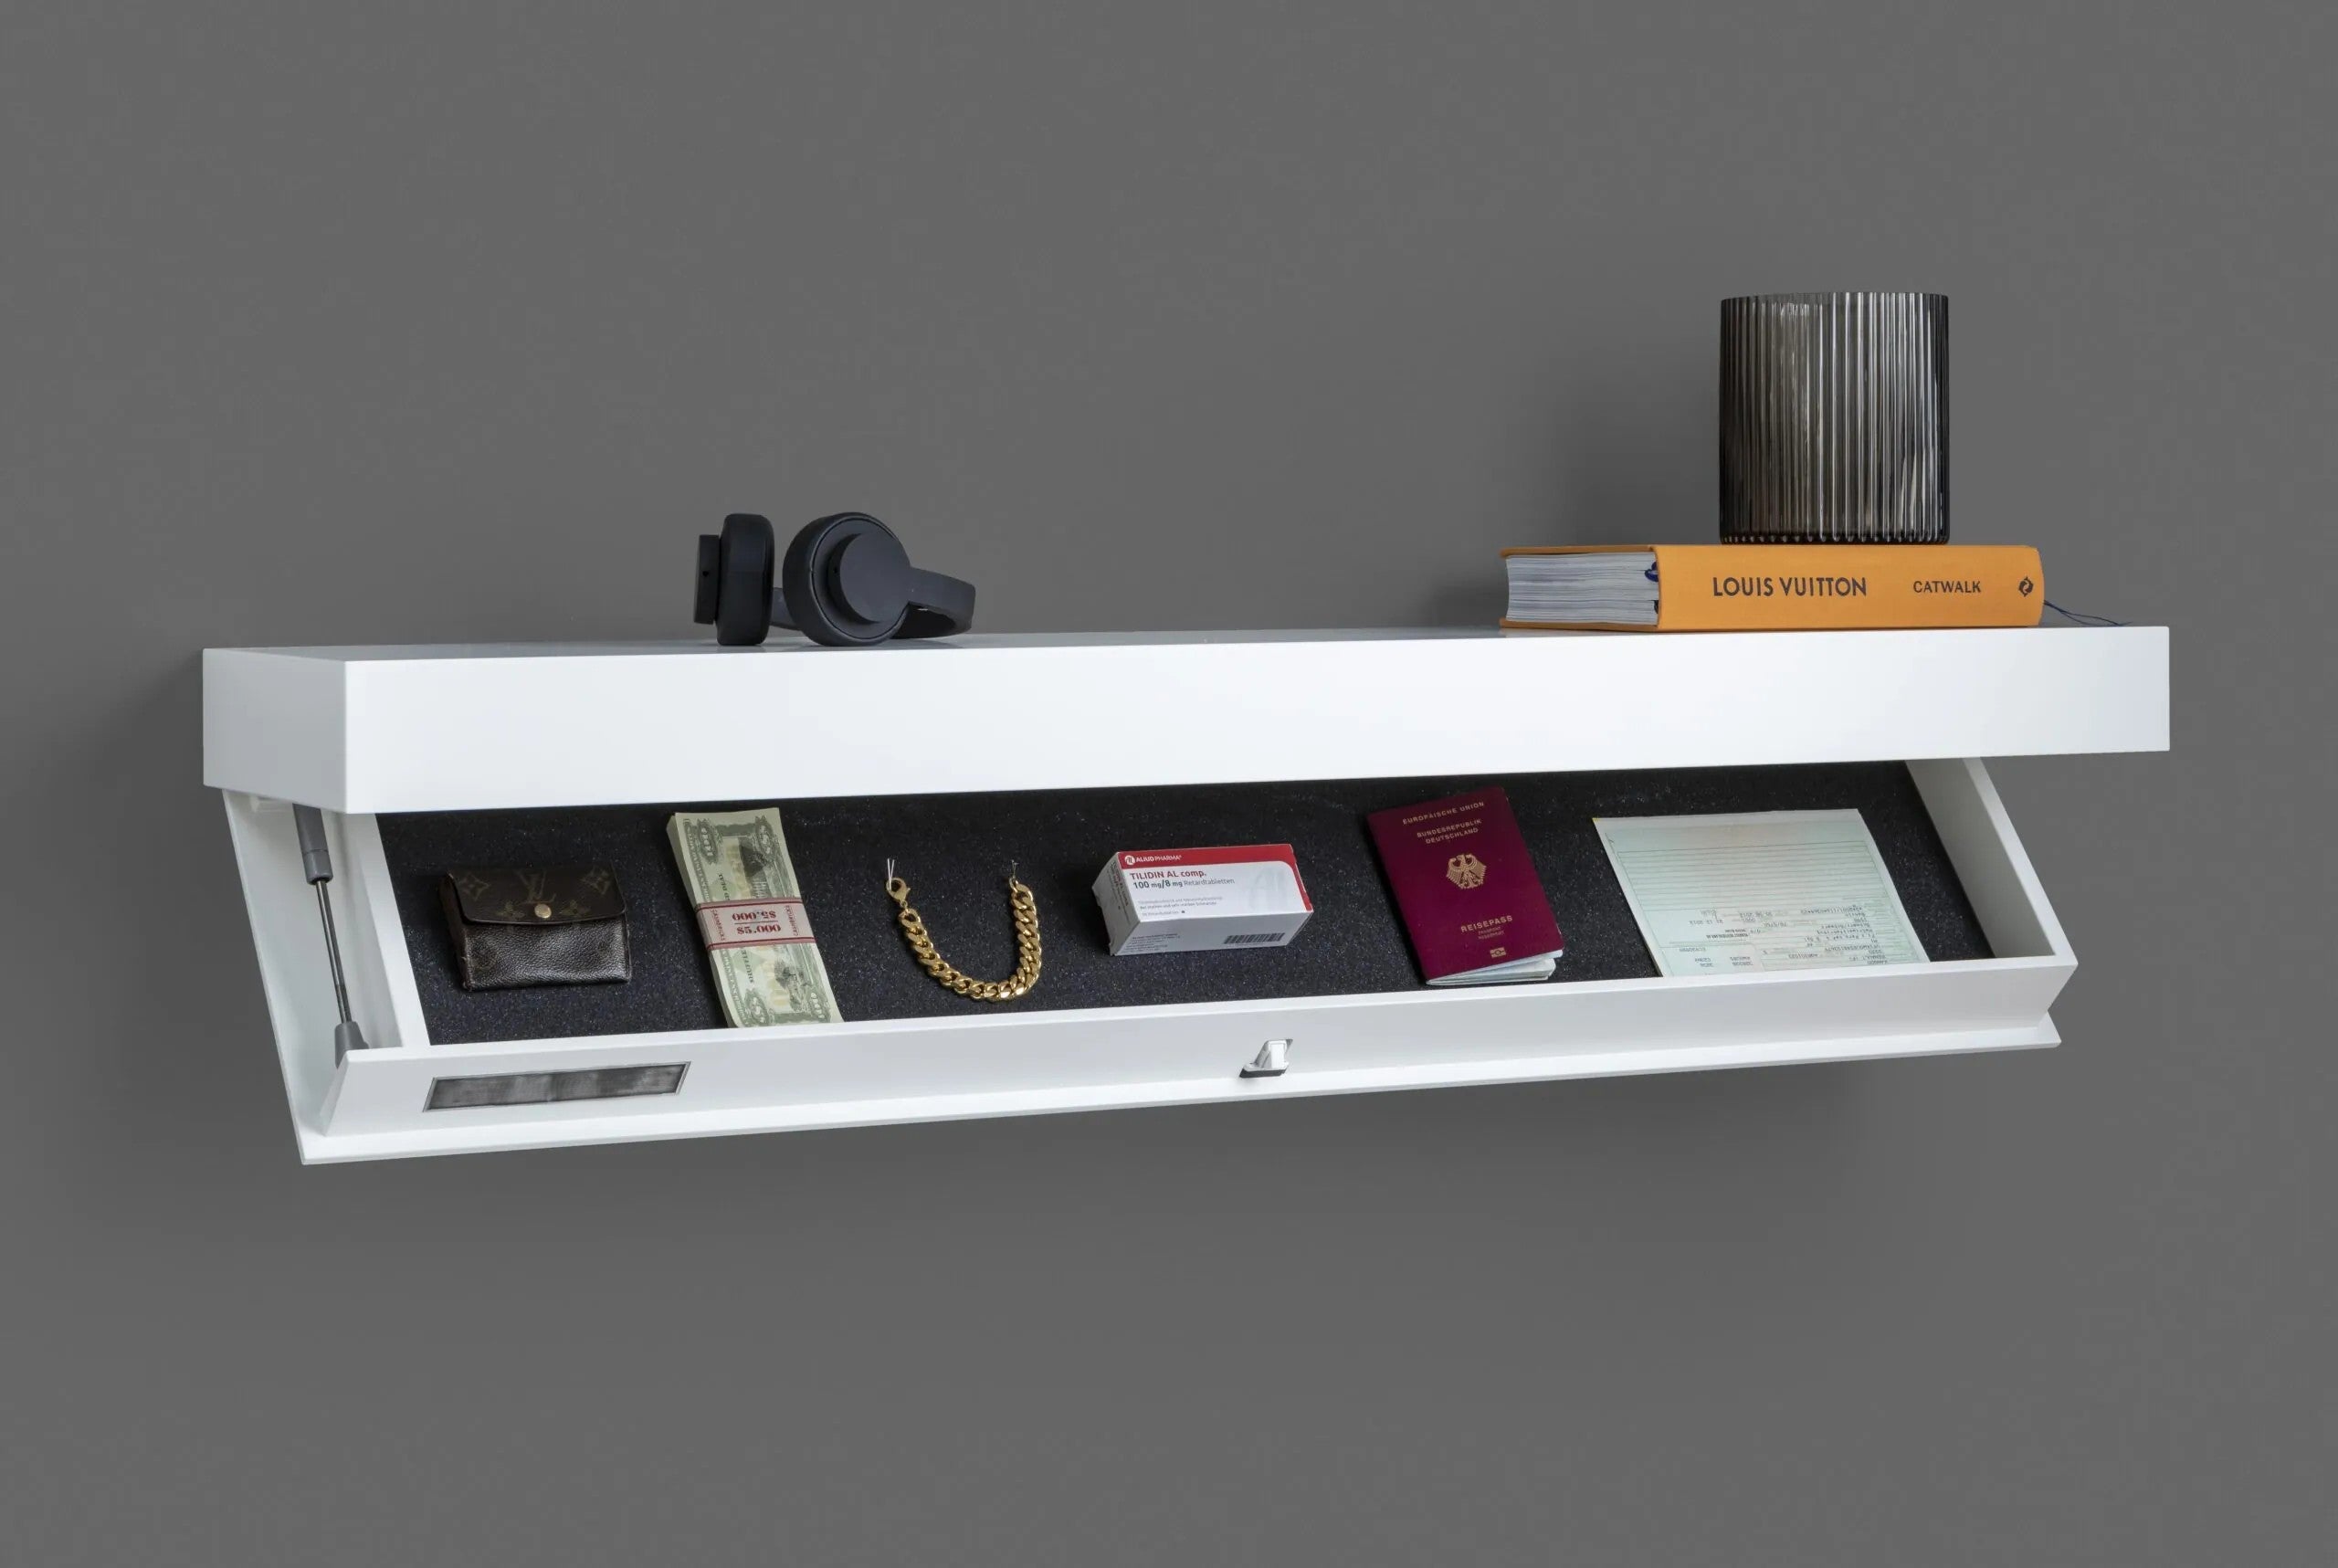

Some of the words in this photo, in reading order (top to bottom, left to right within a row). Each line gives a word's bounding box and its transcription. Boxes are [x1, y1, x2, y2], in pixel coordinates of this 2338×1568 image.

[1712, 576, 1774, 597] LOUIS
[1778, 576, 1868, 597] VUITTON
[1912, 580, 1982, 594] CATWALK
[1459, 801, 1485, 813] UNION
[1416, 819, 1482, 838] BUNDESREPUBLIK
[1426, 827, 1480, 845] DEUTSCHLAND
[1129, 870, 1164, 880] TILIDIN
[1180, 869, 1207, 879] comp.
[1132, 880, 1150, 889] 100
[1460, 915, 1513, 932] REISEPASS
